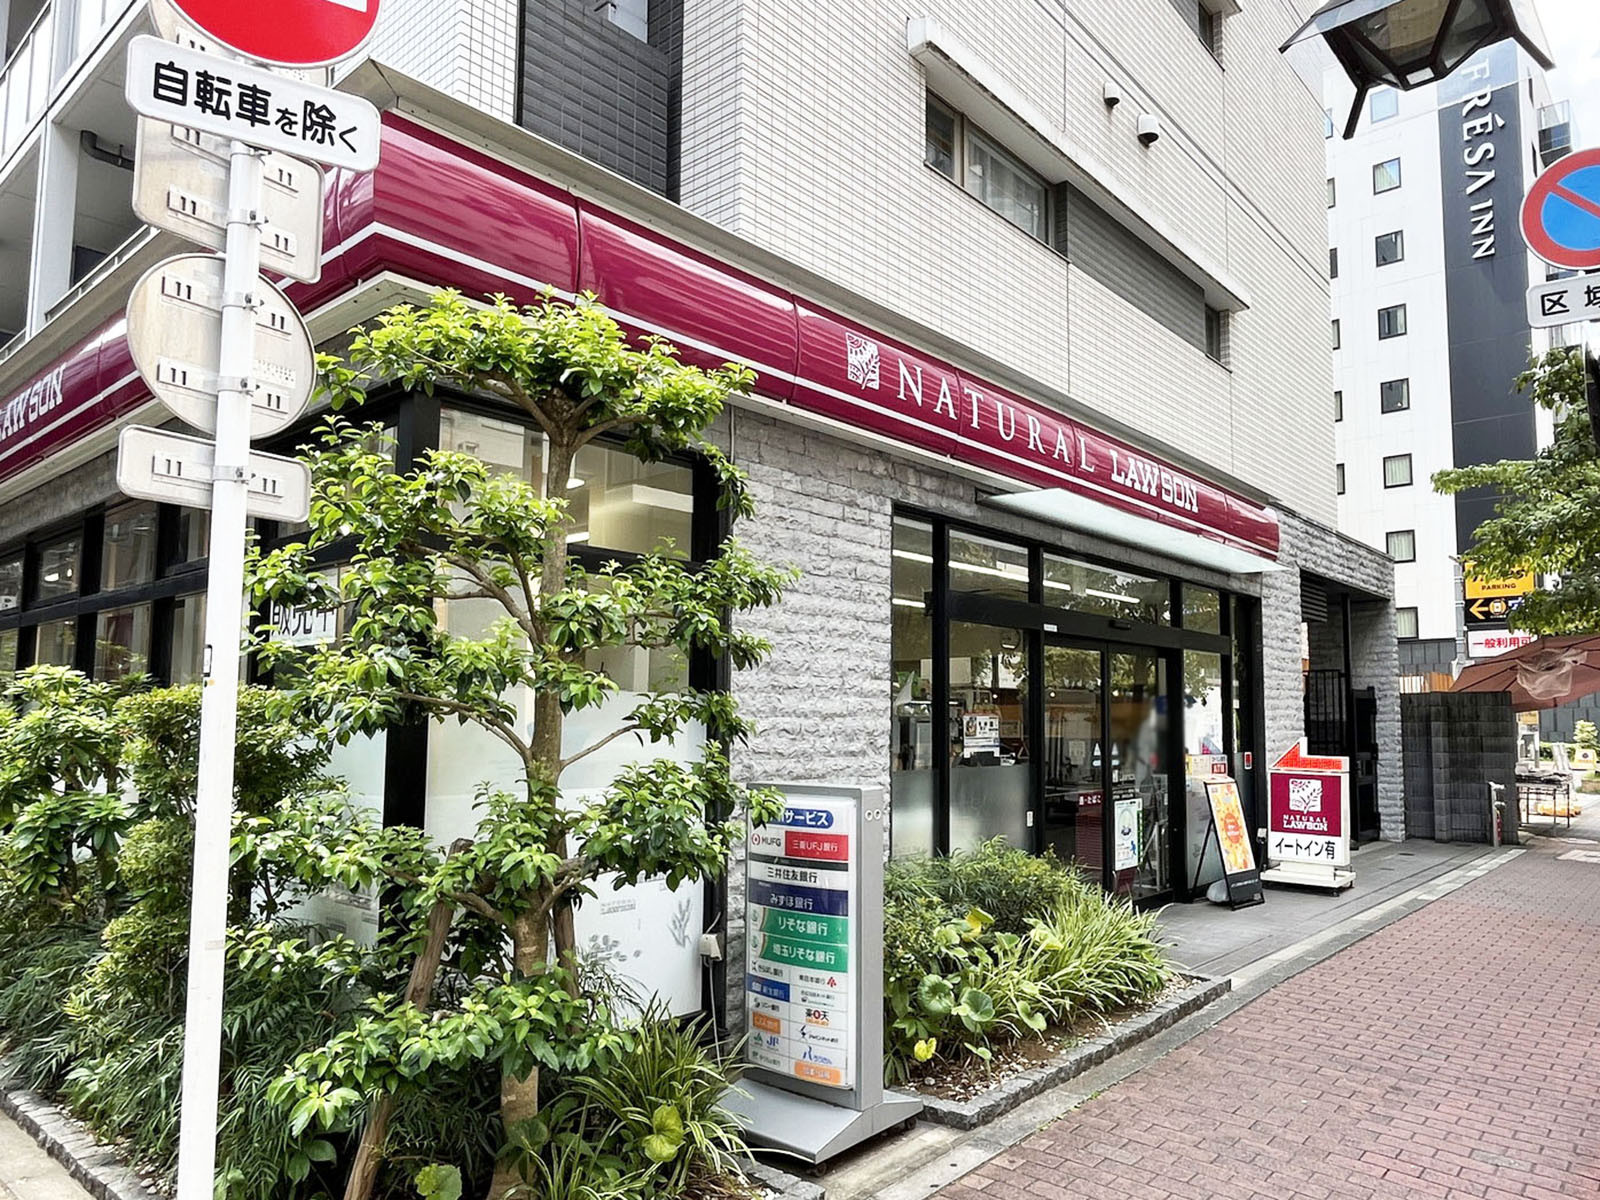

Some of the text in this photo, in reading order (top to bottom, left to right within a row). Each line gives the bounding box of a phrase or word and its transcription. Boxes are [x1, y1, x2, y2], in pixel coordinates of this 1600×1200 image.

[152, 61, 358, 153] 自転車を除く
[1469, 200, 1496, 260] INN
[0, 362, 67, 441] AWSON
[897, 358, 1199, 513] NATURAL LAWSON
[1481, 583, 1516, 591] PARKING
[1283, 814, 1328, 824] NATURAL
[1283, 820, 1328, 832] LAWSON
[1275, 838, 1336, 860] イートイン有
[767, 866, 818, 884] 三井住友銀行
[770, 893, 814, 910] みずほ銀行
[778, 916, 829, 936] りそな銀行
[772, 943, 836, 964] 埼玉りそな銀行
